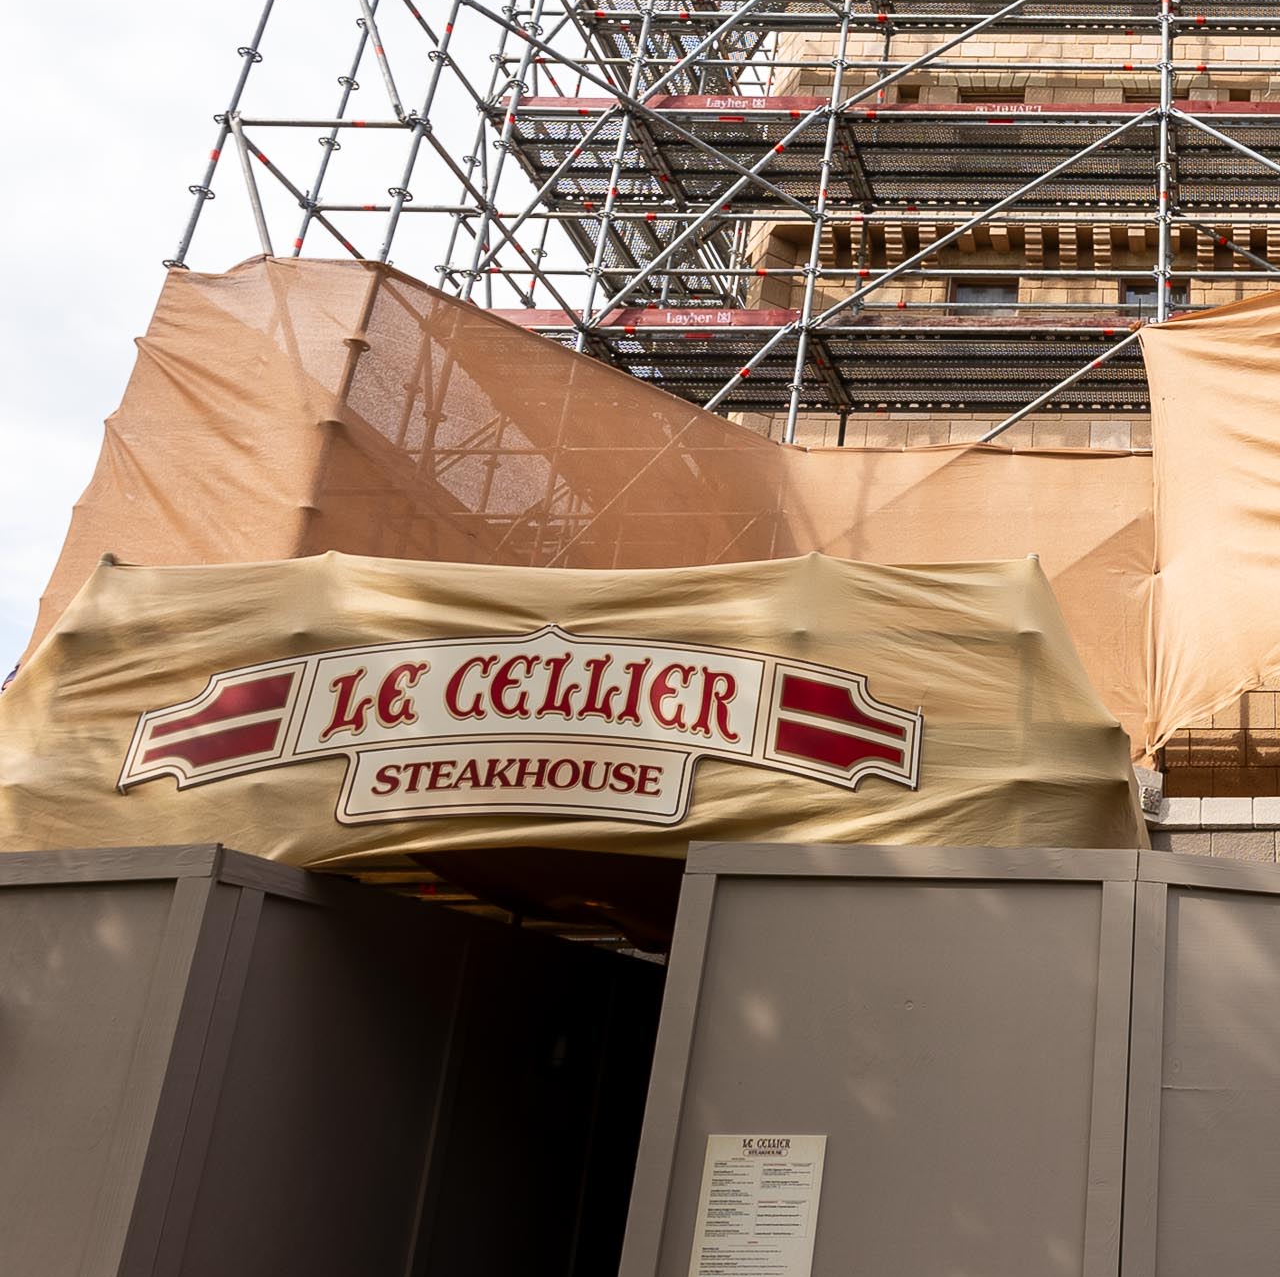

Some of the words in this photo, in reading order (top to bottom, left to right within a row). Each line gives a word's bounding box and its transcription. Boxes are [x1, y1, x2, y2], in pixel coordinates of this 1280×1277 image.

[706, 98, 748, 109] Layher
[666, 312, 712, 325] Layher
[321, 660, 430, 741] LE
[445, 652, 740, 742] CELLIER
[370, 757, 664, 798] STEAKHOUSE
